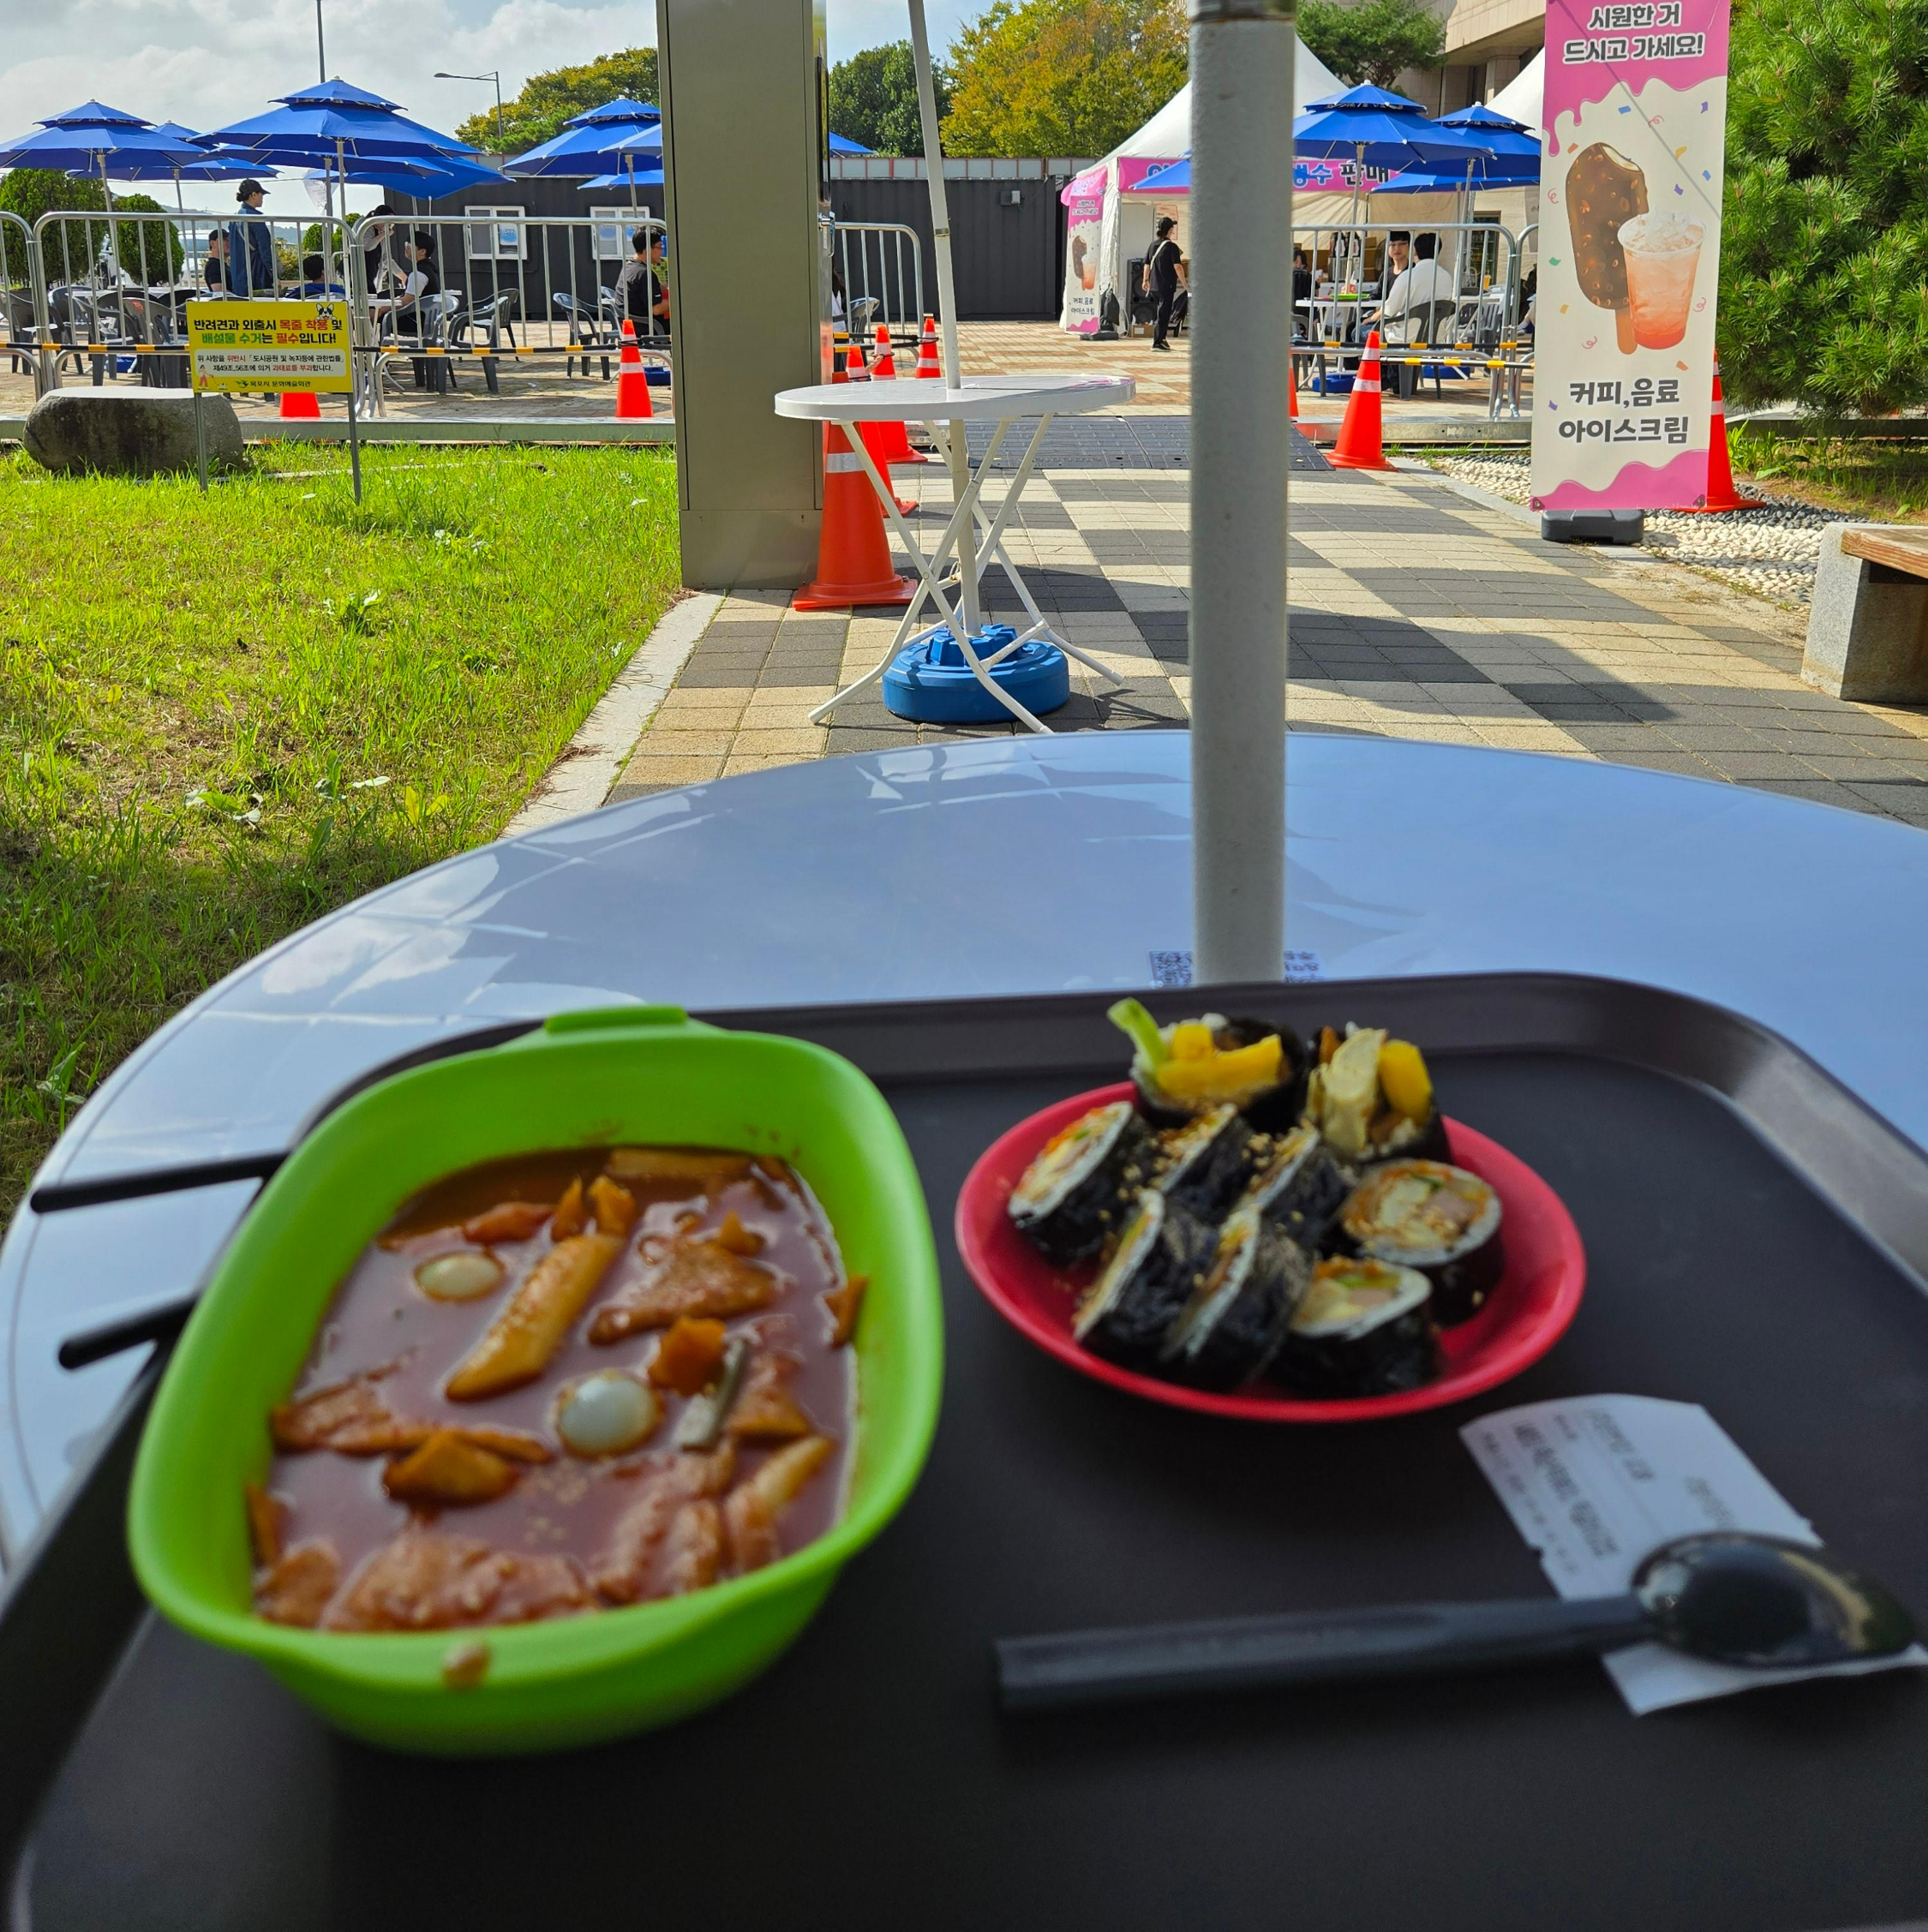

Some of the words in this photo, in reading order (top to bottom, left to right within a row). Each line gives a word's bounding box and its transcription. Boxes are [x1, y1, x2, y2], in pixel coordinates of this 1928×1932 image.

[1588, 4, 1655, 30] 시원한
[1657, 3, 1681, 27] 거
[1563, 38, 1628, 63] 드시고
[1632, 33, 1704, 59] 가세요!
[1339, 164, 1390, 186] 판매
[194, 319, 240, 331] 반려견과
[242, 319, 277, 331] 외출시
[279, 319, 302, 331] 목줄
[305, 319, 328, 331] 착용
[332, 319, 343, 331] 및
[202, 332, 236, 344] 배설물
[239, 332, 273, 344] 수거는
[276, 332, 337, 344] 필수입니다!
[1570, 378, 1680, 409] 커피,음료
[1558, 416, 1689, 444] 아이스크림
